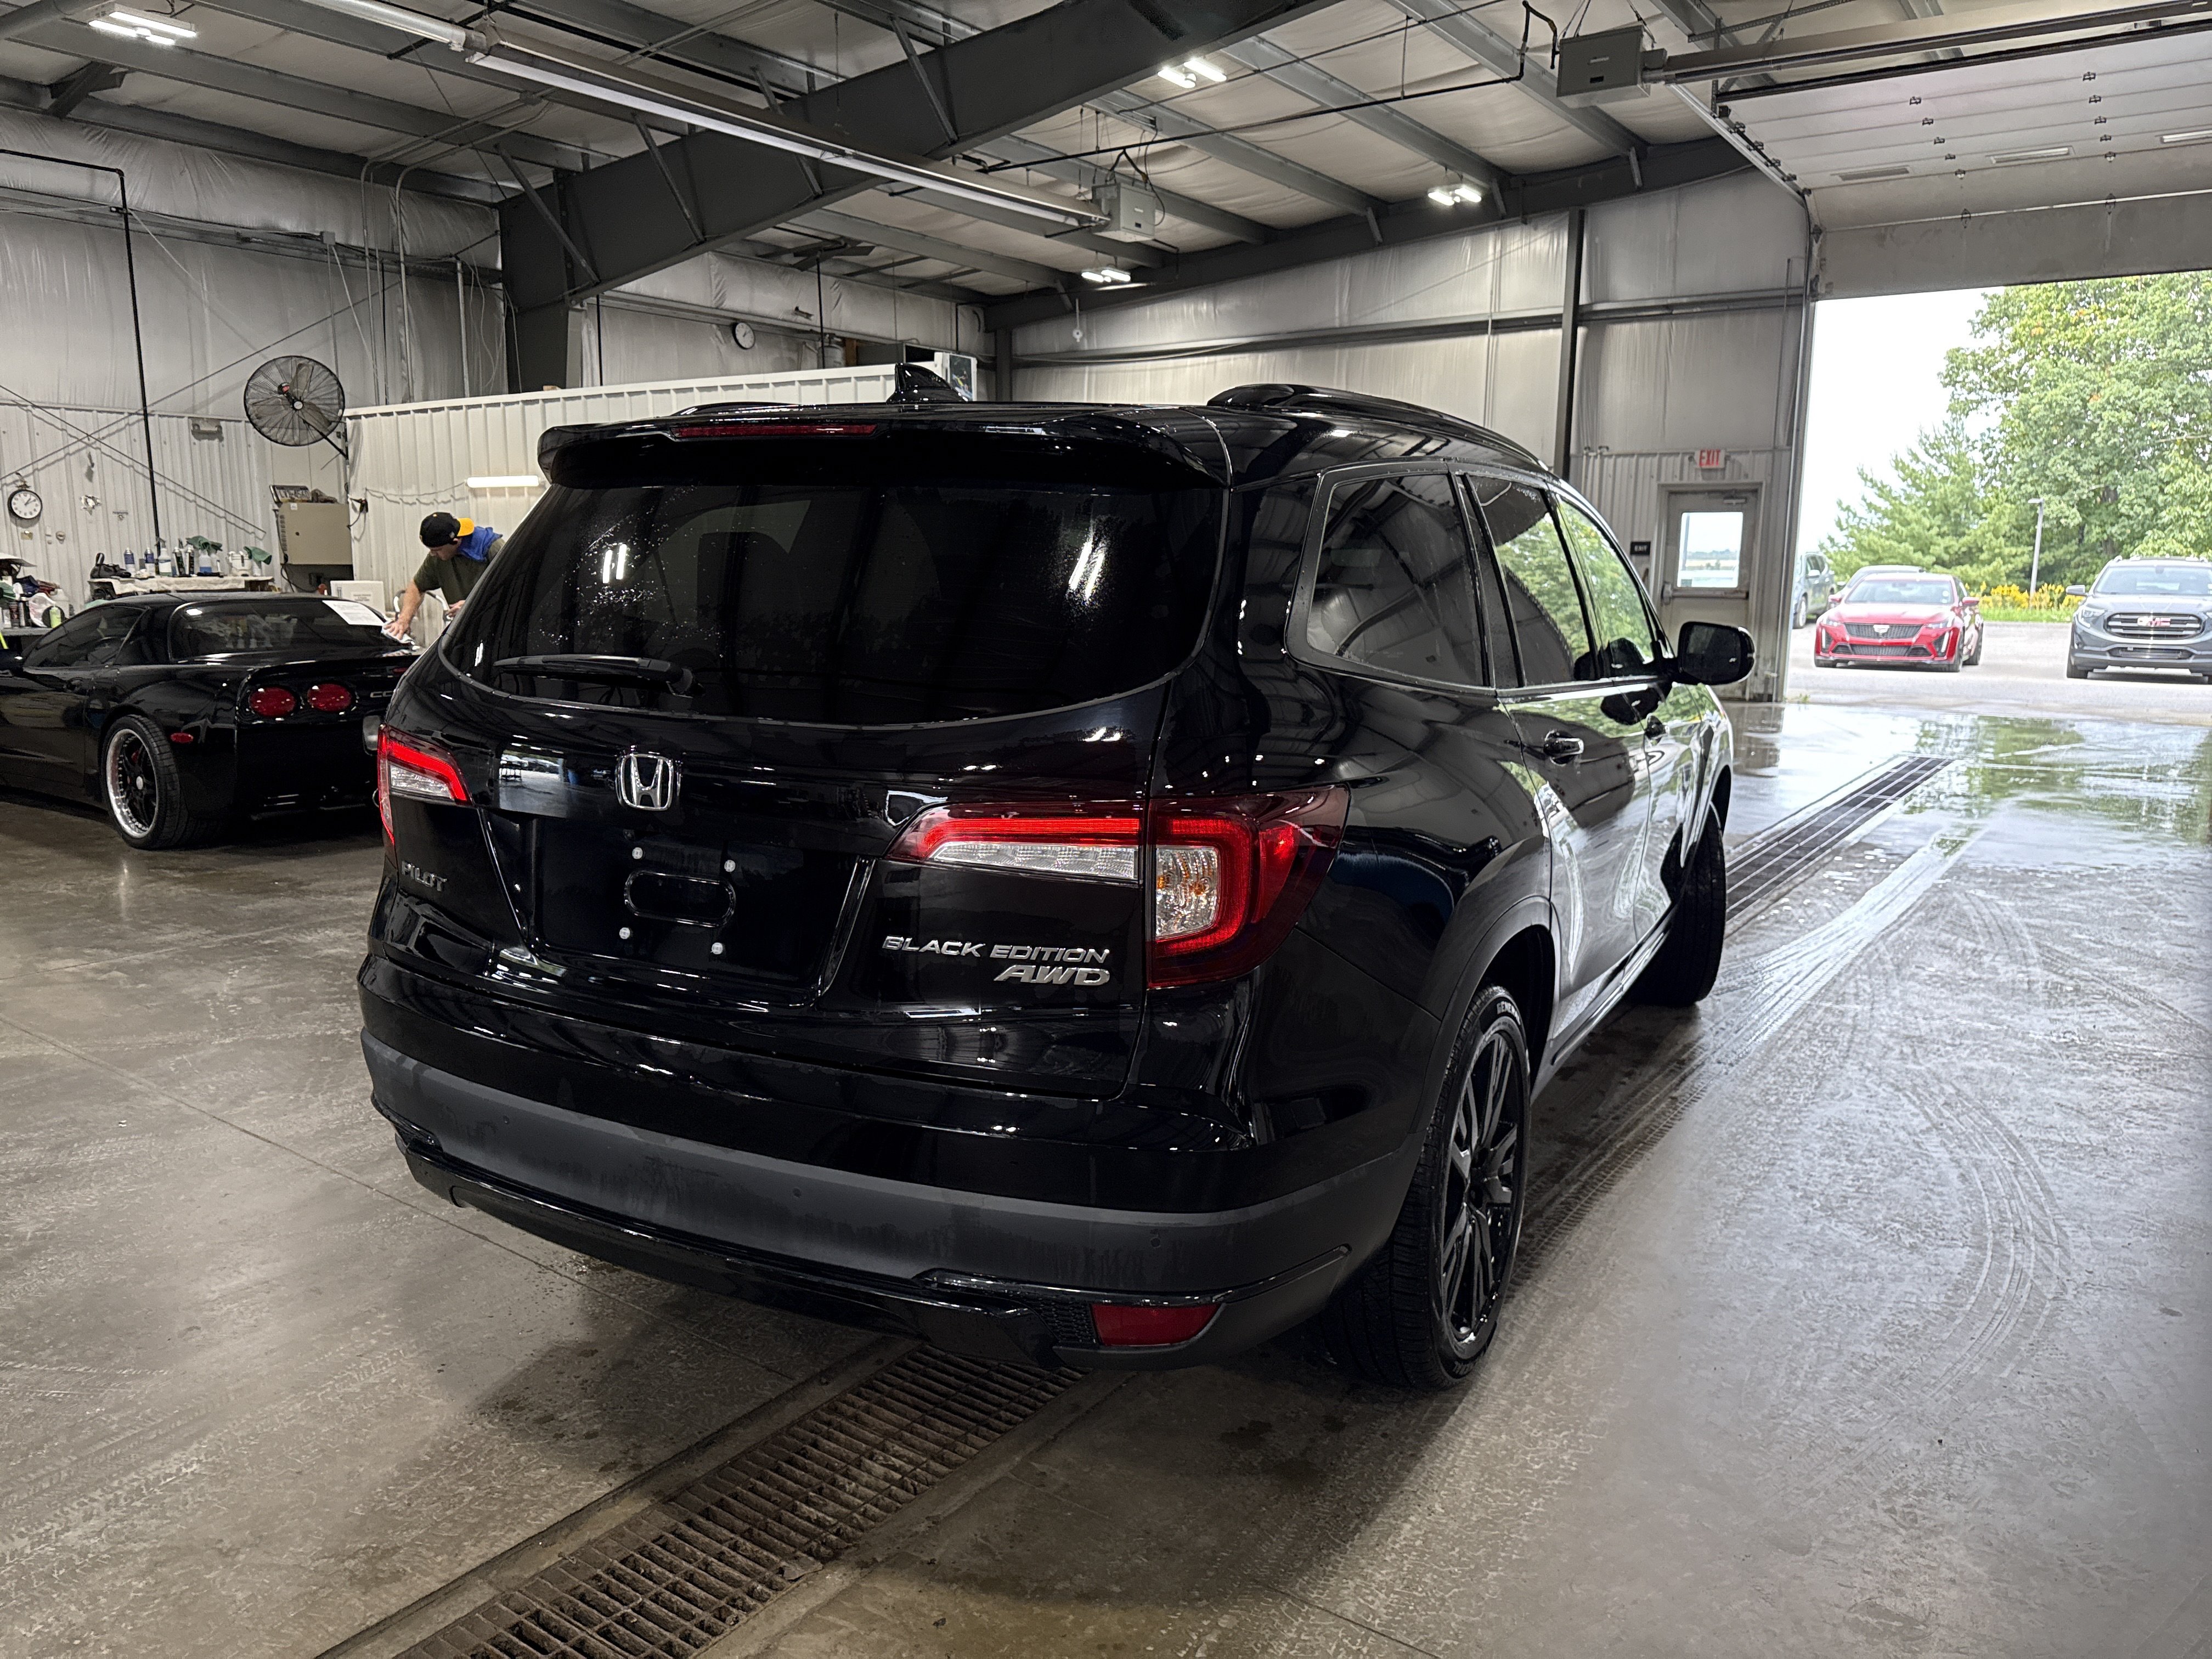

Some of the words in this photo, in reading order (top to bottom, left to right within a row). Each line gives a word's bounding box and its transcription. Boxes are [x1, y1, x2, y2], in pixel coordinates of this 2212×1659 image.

[1699, 449, 1721, 467] EXIT
[401, 860, 448, 891] PILOT
[882, 935, 986, 957] BLACK
[989, 944, 1110, 964] EDITION
[994, 964, 1110, 986] AWD
